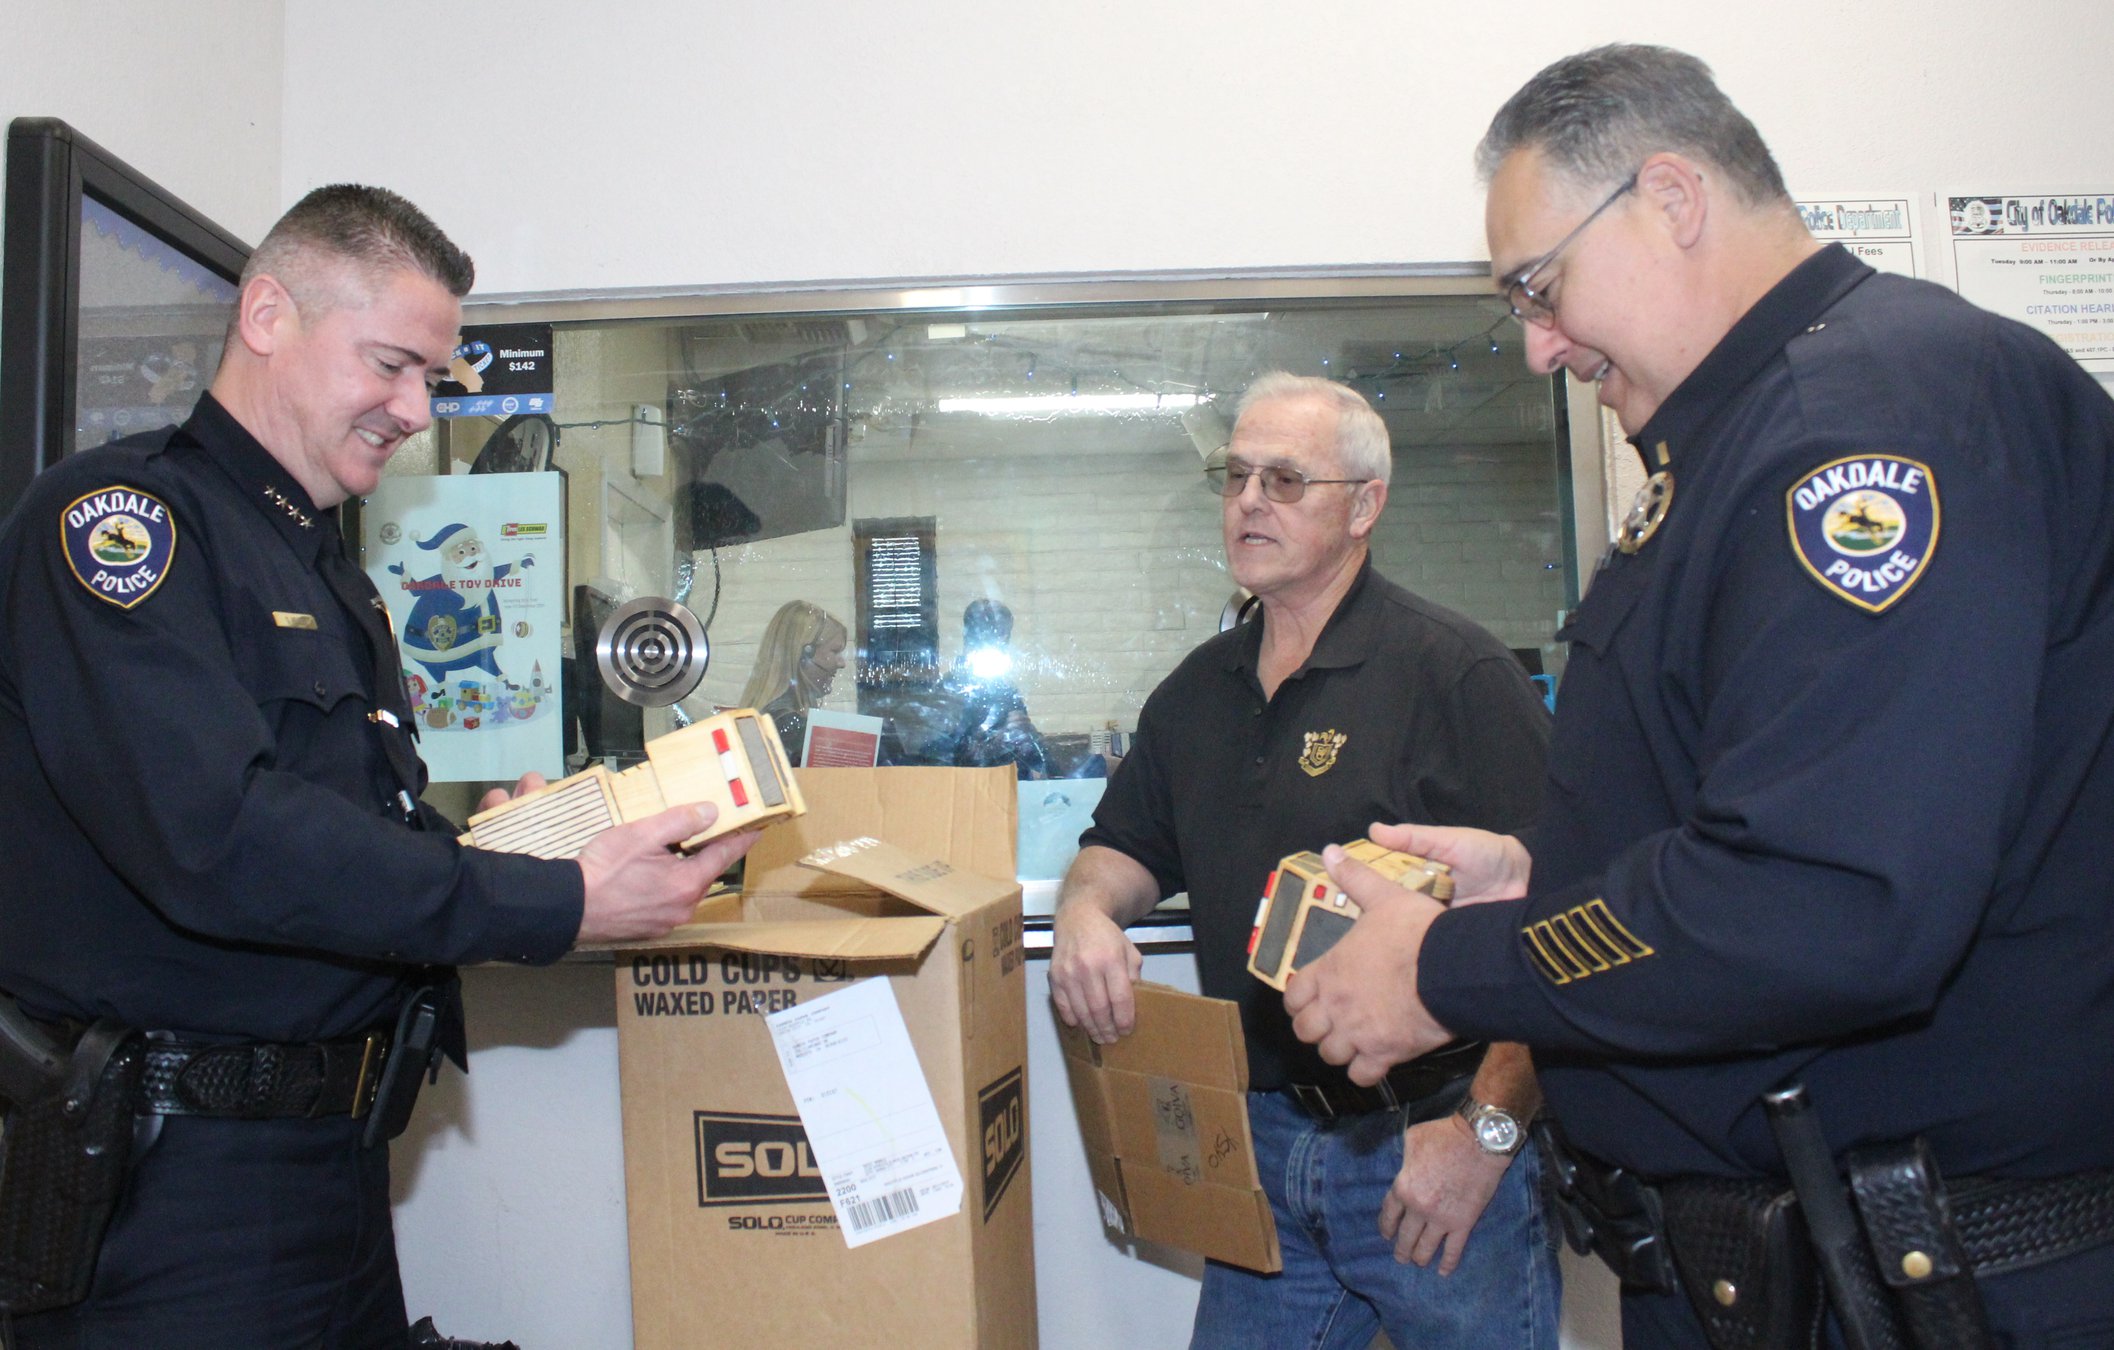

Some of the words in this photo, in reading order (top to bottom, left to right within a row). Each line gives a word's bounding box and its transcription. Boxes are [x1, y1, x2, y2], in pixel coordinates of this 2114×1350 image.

[1836, 203, 1903, 236] Department
[2006, 199, 2029, 232] City
[2032, 199, 2045, 226] of
[2048, 198, 2094, 226] Oakdale
[1857, 246, 1884, 256] Fees
[2021, 242, 2078, 253] EVIDENCE
[2039, 273, 2113, 285] FINGERPRINT
[2026, 304, 2078, 315] CITATION
[499, 348, 545, 359] Minimum
[508, 361, 536, 372] $142
[1794, 460, 1925, 511] OAKDALE
[68, 492, 166, 529] OAKDALE
[91, 565, 157, 593] POLICE
[1825, 550, 1918, 592] POLICE
[459, 579, 482, 589] TOY
[484, 578, 522, 589] DRIVE
[632, 953, 708, 987] COLD
[721, 952, 801, 986] CUPS
[634, 991, 715, 1017] WAXED
[723, 988, 798, 1015] PAPER
[984, 1096, 1020, 1178] SOLO
[715, 1141, 822, 1178] SOL
[835, 1184, 857, 1197] 2200
[839, 1195, 861, 1209] F621
[728, 1216, 783, 1230] SOLO
[785, 1214, 806, 1224] CUP
[808, 1214, 839, 1224] COMP
